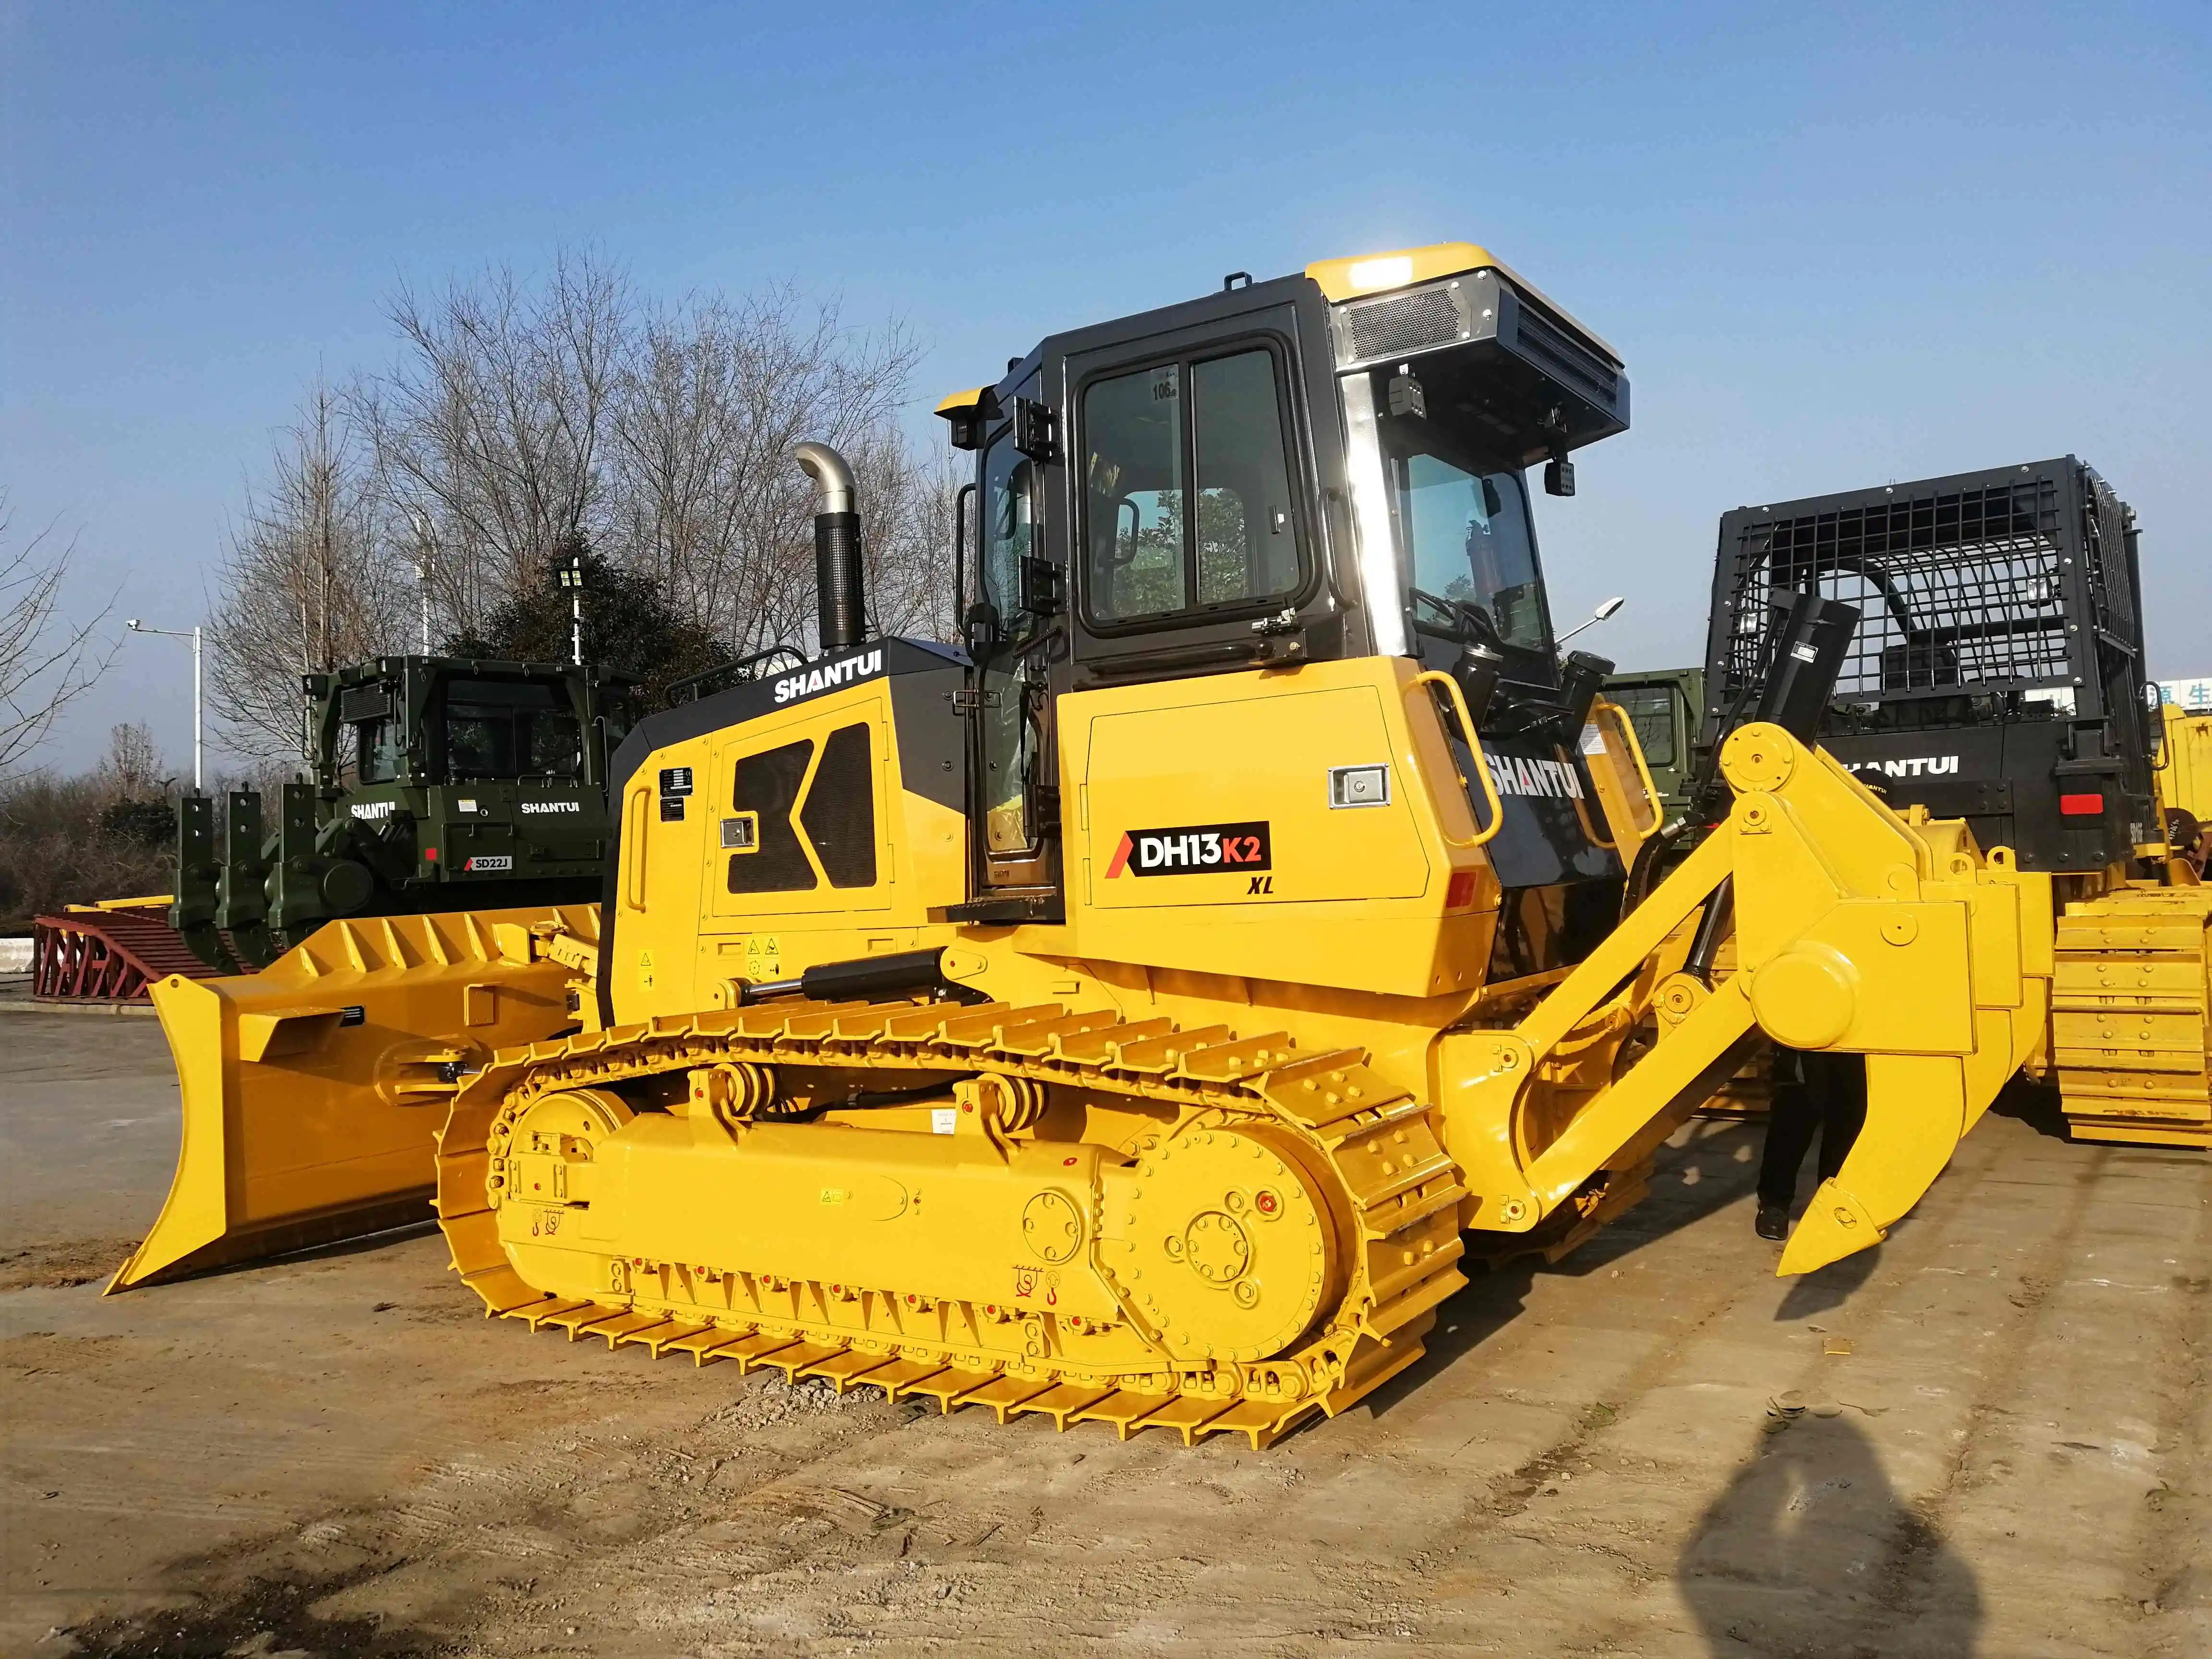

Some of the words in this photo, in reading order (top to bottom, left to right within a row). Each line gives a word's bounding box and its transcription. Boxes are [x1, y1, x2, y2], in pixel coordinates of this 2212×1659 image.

[774, 649, 882, 703] SHANTUI
[1482, 752, 1585, 799] SHANTUI
[1842, 756, 1959, 777] NTUI
[1864, 784, 1887, 794] HANTUI
[521, 802, 580, 814] SHANTUI
[1140, 833, 1262, 868] DH13K2
[476, 859, 507, 868] SD22J
[1247, 877, 1274, 895] XL
